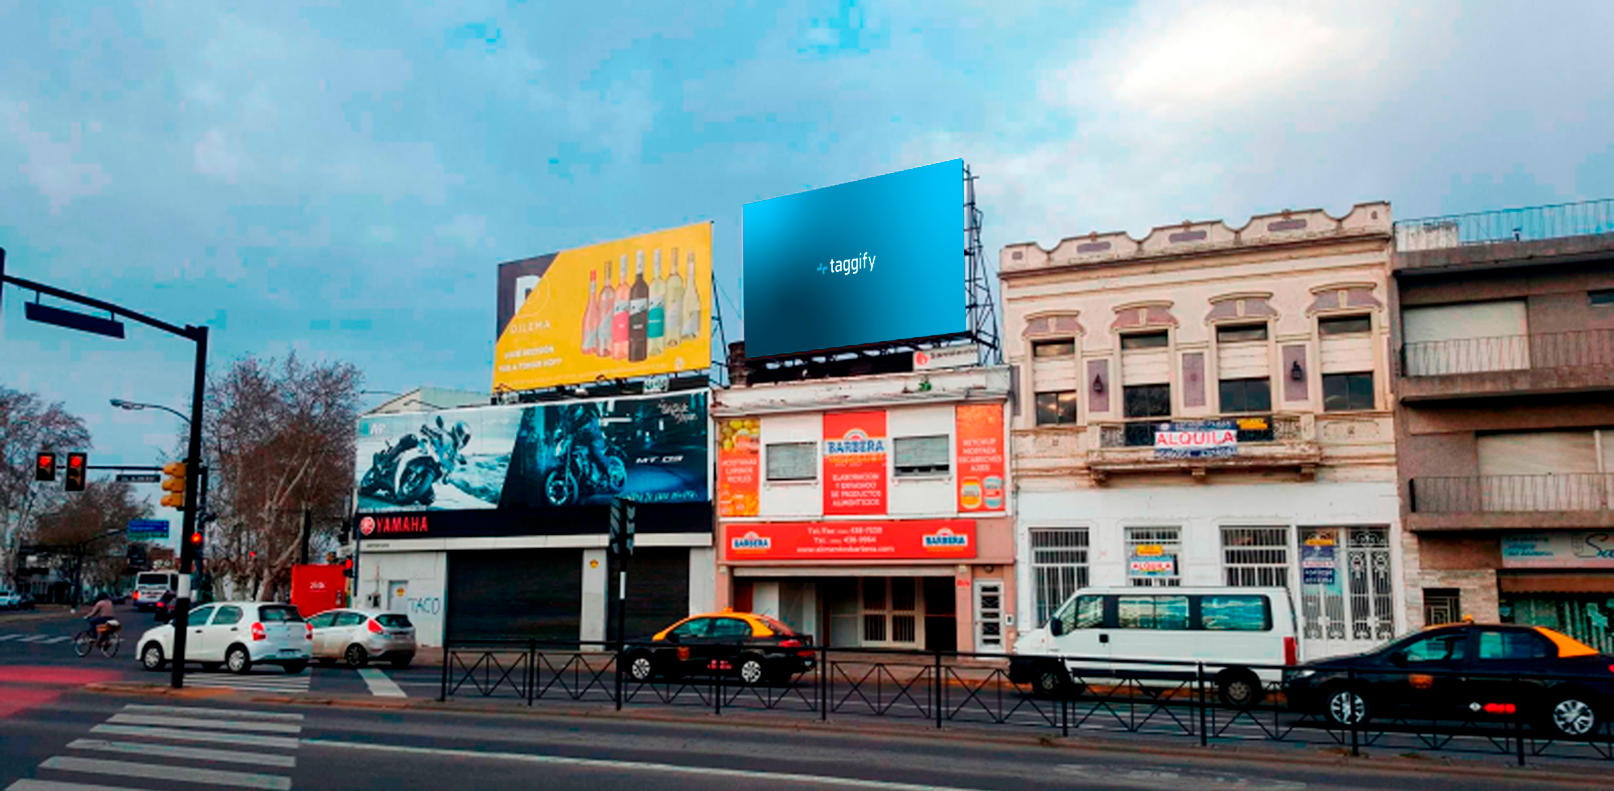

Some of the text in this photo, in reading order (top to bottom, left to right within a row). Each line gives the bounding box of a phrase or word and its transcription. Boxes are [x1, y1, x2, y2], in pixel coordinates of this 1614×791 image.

[830, 251, 876, 275] taggify
[510, 320, 551, 335] DILEMA
[1157, 431, 1233, 445] ALQUILA
[827, 440, 885, 453] BARBERA
[841, 490, 881, 498] PRODUCTOS
[376, 516, 429, 534] YAMAHA
[734, 539, 769, 548] BARBERA
[925, 536, 966, 545] BARBERA
